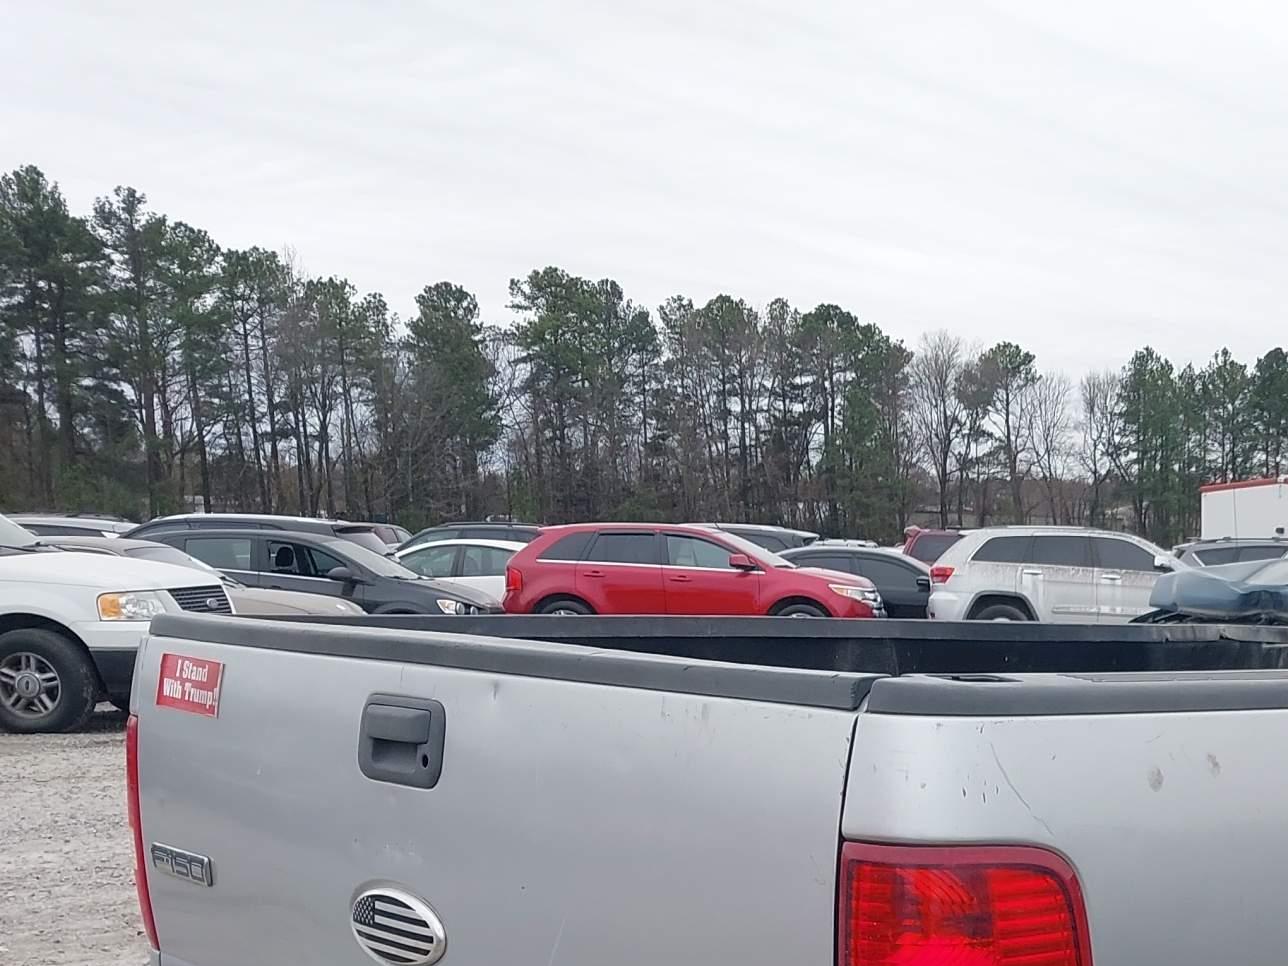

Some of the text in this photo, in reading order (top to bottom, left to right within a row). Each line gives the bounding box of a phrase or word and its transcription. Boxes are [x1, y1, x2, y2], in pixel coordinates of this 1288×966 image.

[176, 659, 208, 682] I Stand
[163, 678, 182, 699] With
